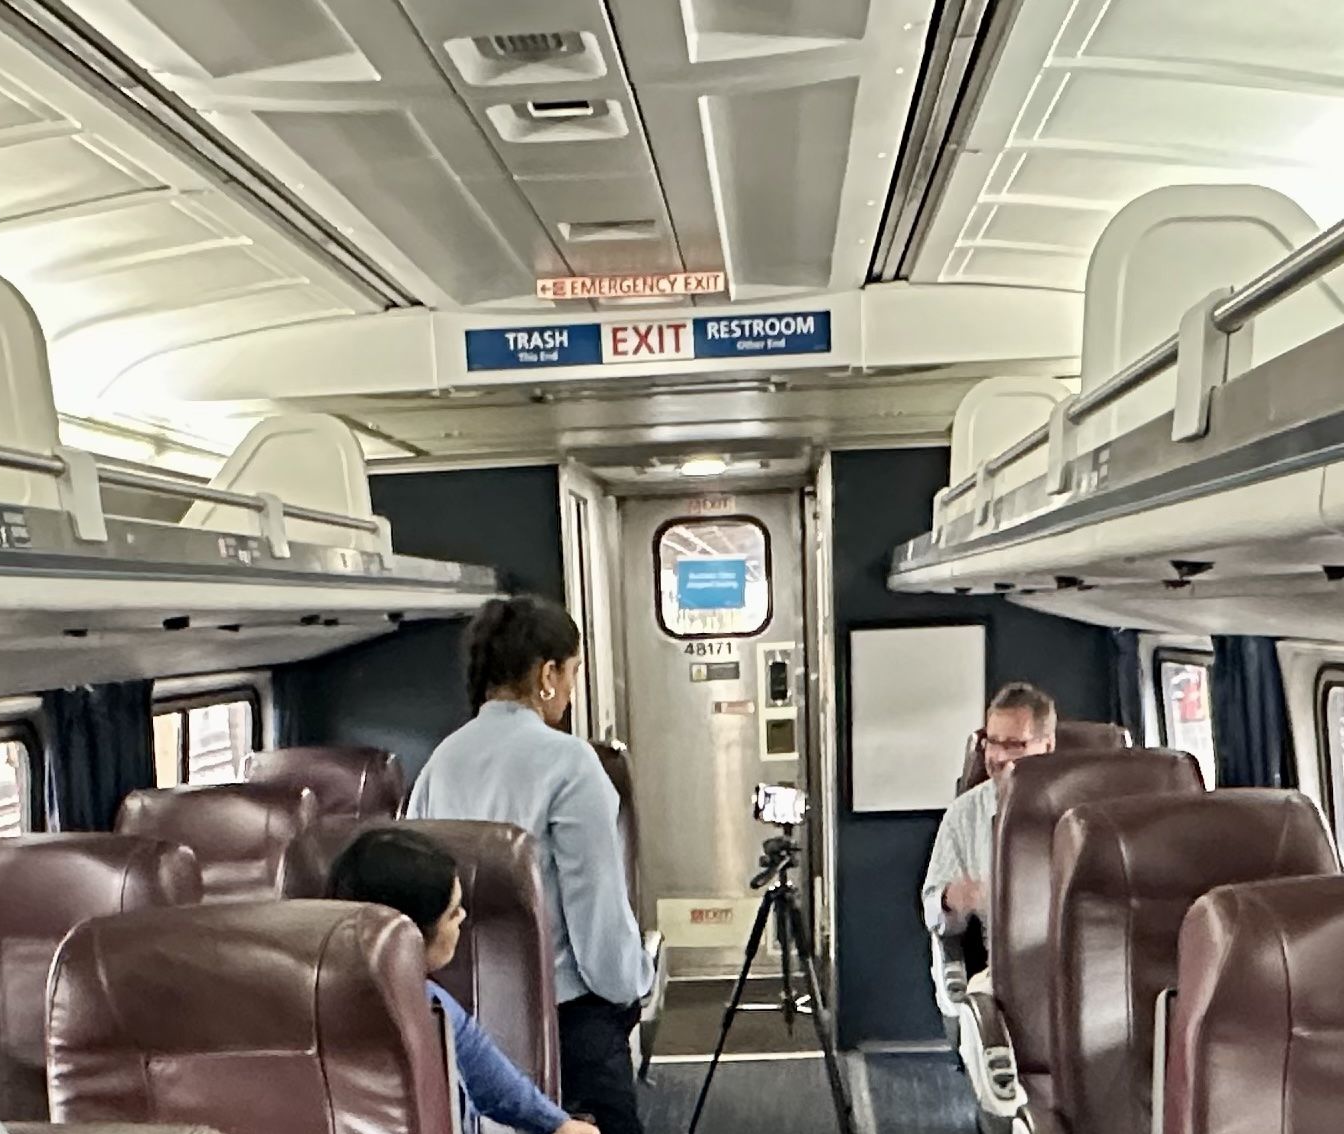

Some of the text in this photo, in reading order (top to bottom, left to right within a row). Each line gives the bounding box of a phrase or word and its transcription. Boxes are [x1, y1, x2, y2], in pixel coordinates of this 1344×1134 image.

[571, 274, 720, 296] EMERGENCY EXIT
[706, 315, 815, 340] RESTROOM
[504, 329, 569, 351] TRASH
[611, 323, 687, 357] EXIT
[684, 642, 732, 656] 48171
